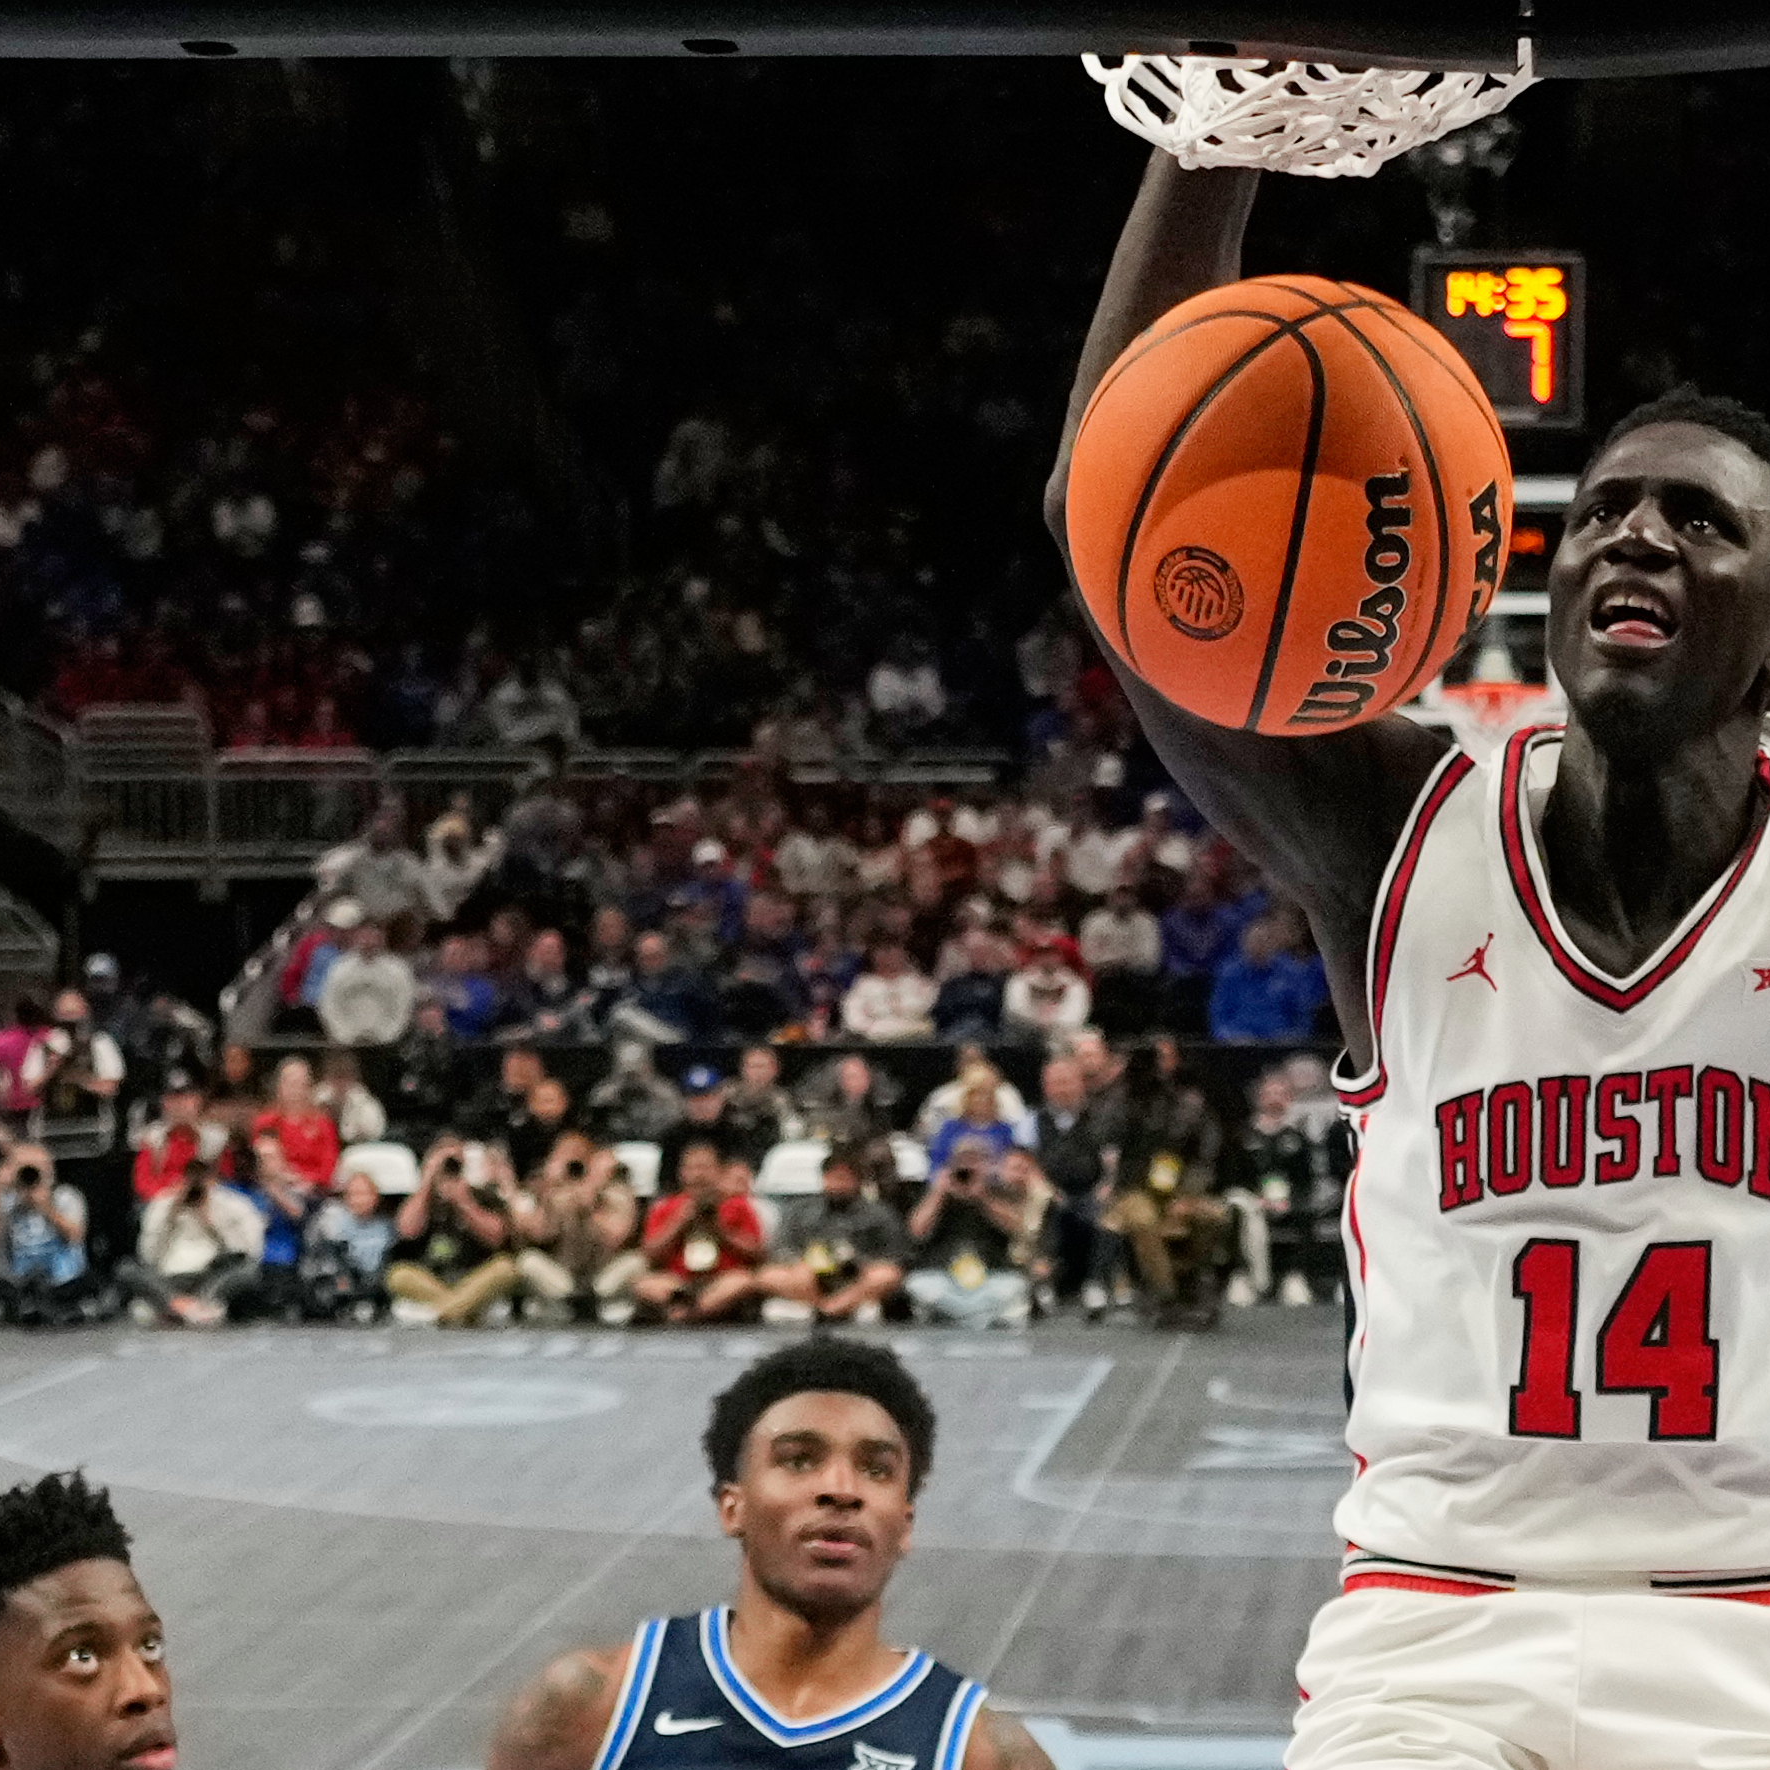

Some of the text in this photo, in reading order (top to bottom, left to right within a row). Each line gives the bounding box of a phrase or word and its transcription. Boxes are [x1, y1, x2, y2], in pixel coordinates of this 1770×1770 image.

[1446, 267, 1567, 321] 14:35
[1503, 320, 1552, 403] 7
[1284, 467, 1412, 725] Wilson
[1509, 1237, 1719, 1441] 14
